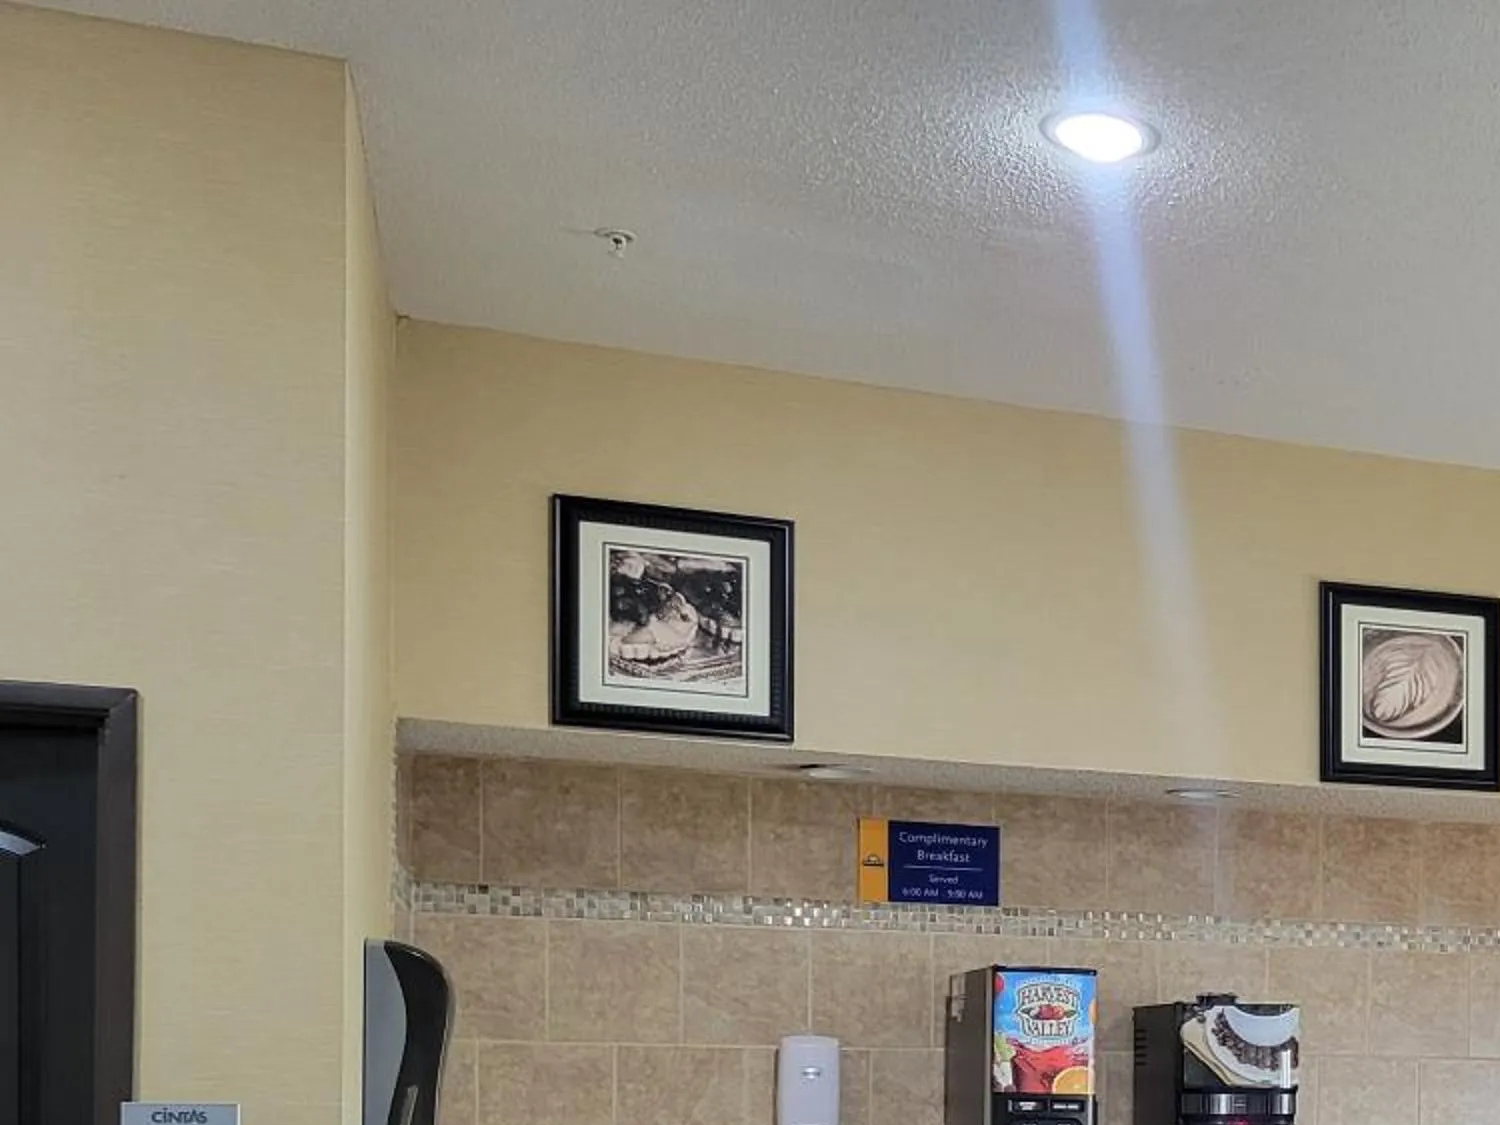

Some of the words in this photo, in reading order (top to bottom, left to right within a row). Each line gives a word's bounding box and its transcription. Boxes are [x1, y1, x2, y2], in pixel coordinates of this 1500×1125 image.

[899, 831, 989, 849] Complimentary
[917, 850, 970, 863] Breakfast
[928, 874, 959, 884] Served
[1018, 984, 1079, 1007] HARVEST
[1021, 1017, 1076, 1037] VALLEY
[151, 1107, 208, 1124] CINTAS
